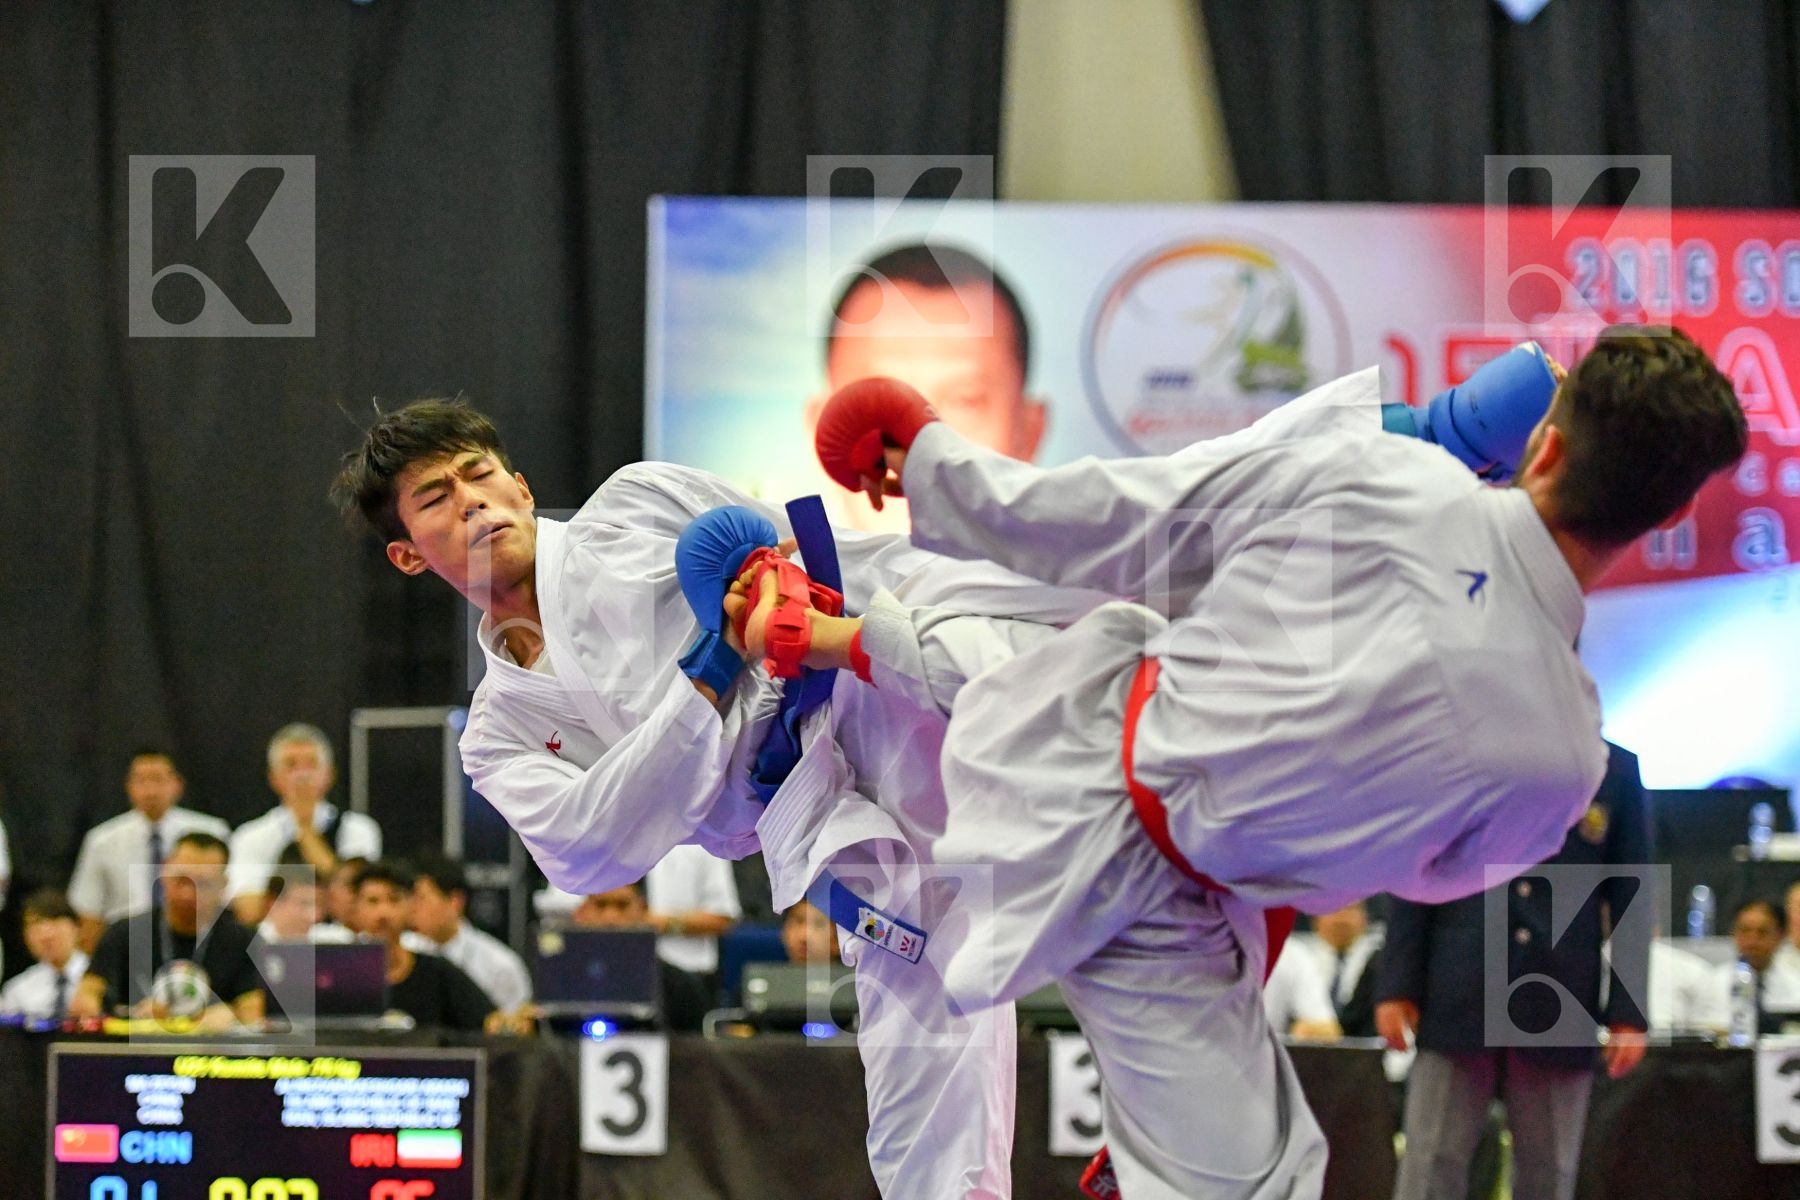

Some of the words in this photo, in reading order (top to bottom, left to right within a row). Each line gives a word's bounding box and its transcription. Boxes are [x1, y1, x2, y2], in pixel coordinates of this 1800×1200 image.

[1563, 238, 1718, 316] 2016
[601, 1050, 647, 1137] 3
[1070, 1053, 1102, 1138] 3
[120, 1130, 192, 1165] CHN
